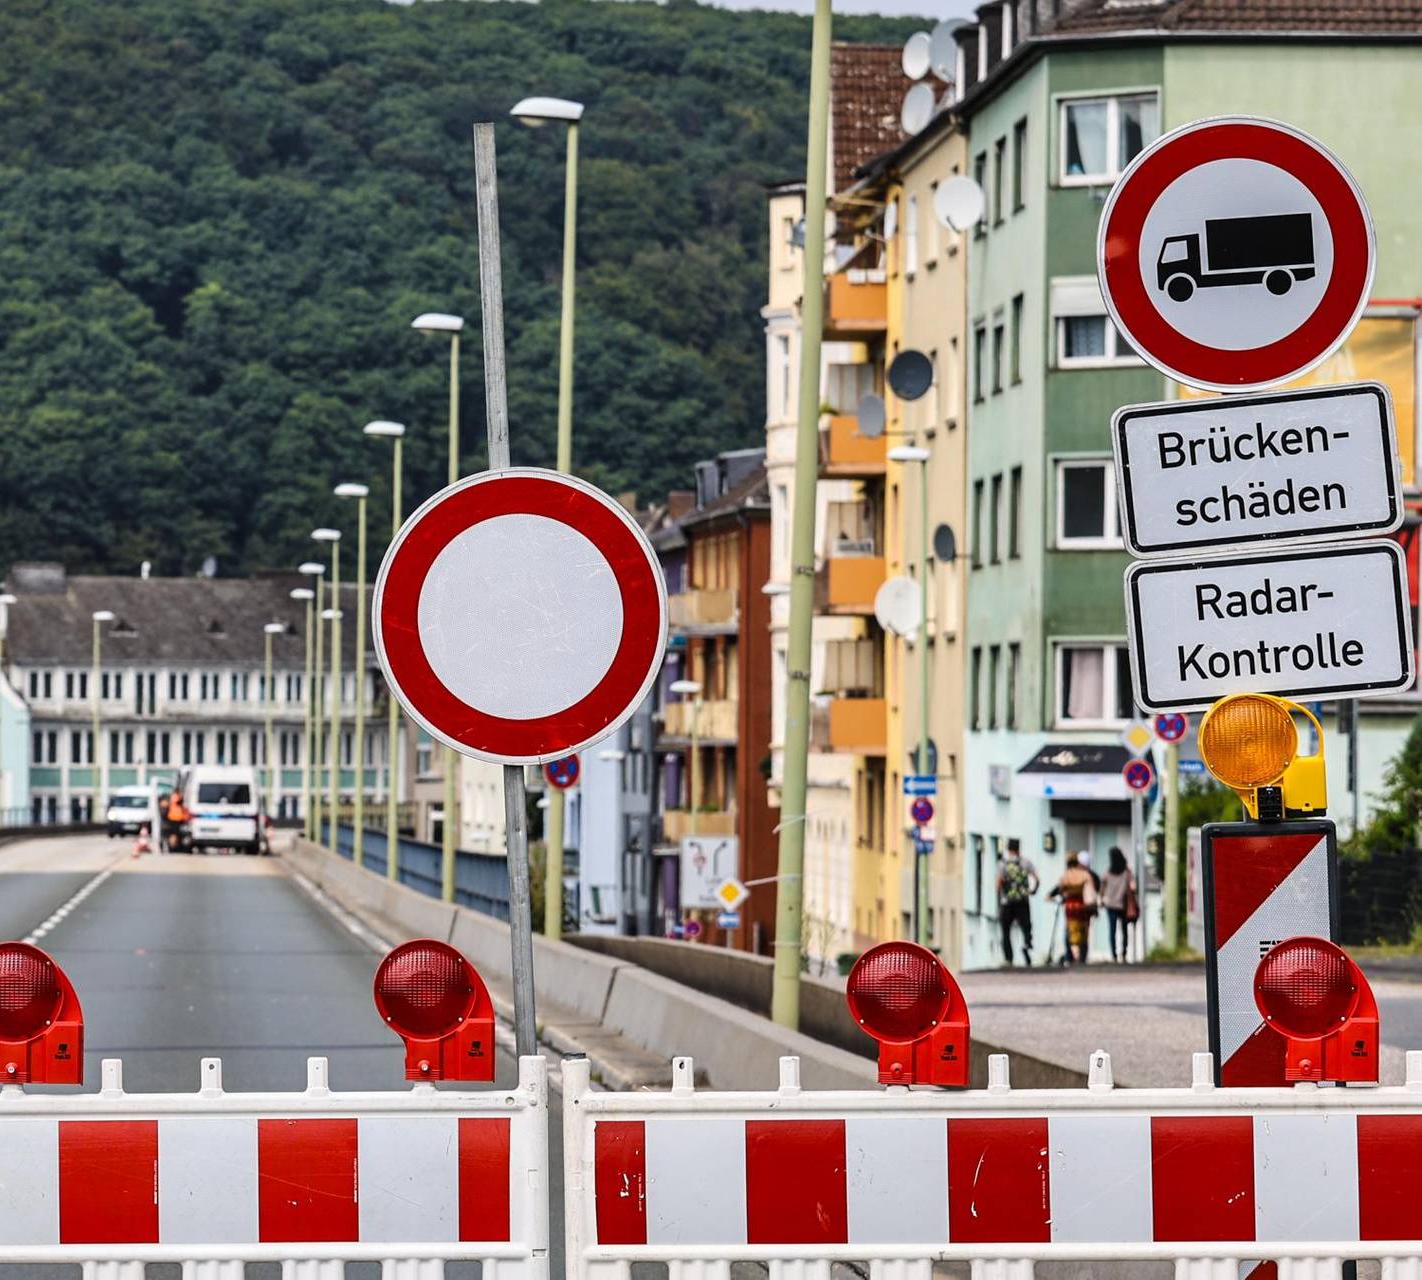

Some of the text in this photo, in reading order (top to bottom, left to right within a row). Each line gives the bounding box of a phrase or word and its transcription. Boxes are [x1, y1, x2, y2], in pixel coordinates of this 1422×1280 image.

[1158, 423, 1350, 470] Brücken-
[1176, 478, 1347, 526] schäden
[1196, 579, 1334, 621] Radar-
[1178, 632, 1364, 681] Kontrolle
